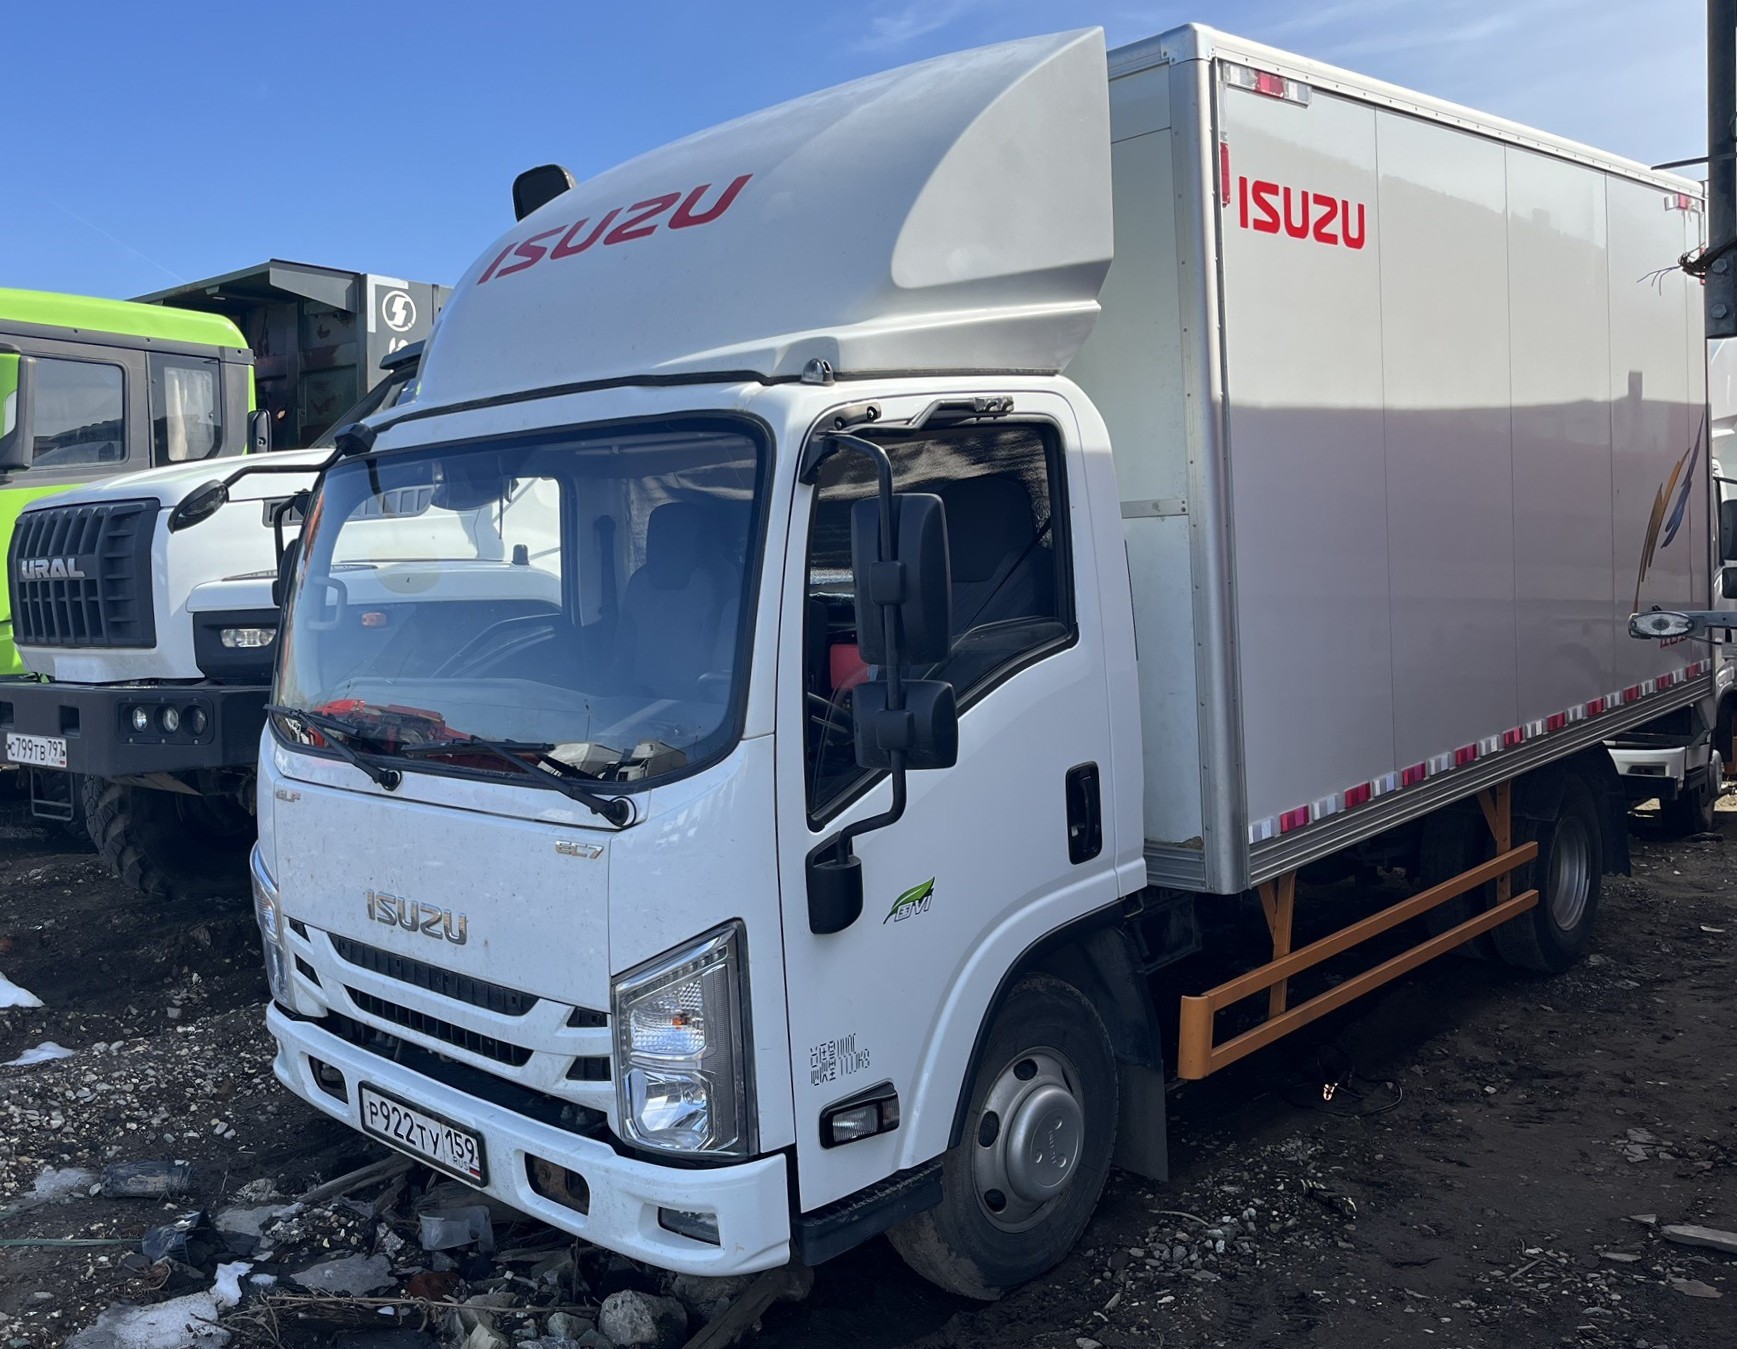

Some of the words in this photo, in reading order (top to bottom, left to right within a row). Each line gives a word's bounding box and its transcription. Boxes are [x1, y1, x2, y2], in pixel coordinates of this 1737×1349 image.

[476, 173, 753, 285] ISUZU
[1239, 176, 1365, 250] ISUZU
[21, 557, 86, 579] URAL
[367, 888, 468, 946] ISUZU
[445, 1129, 475, 1165] 159
[452, 1155, 470, 1172] RUS
